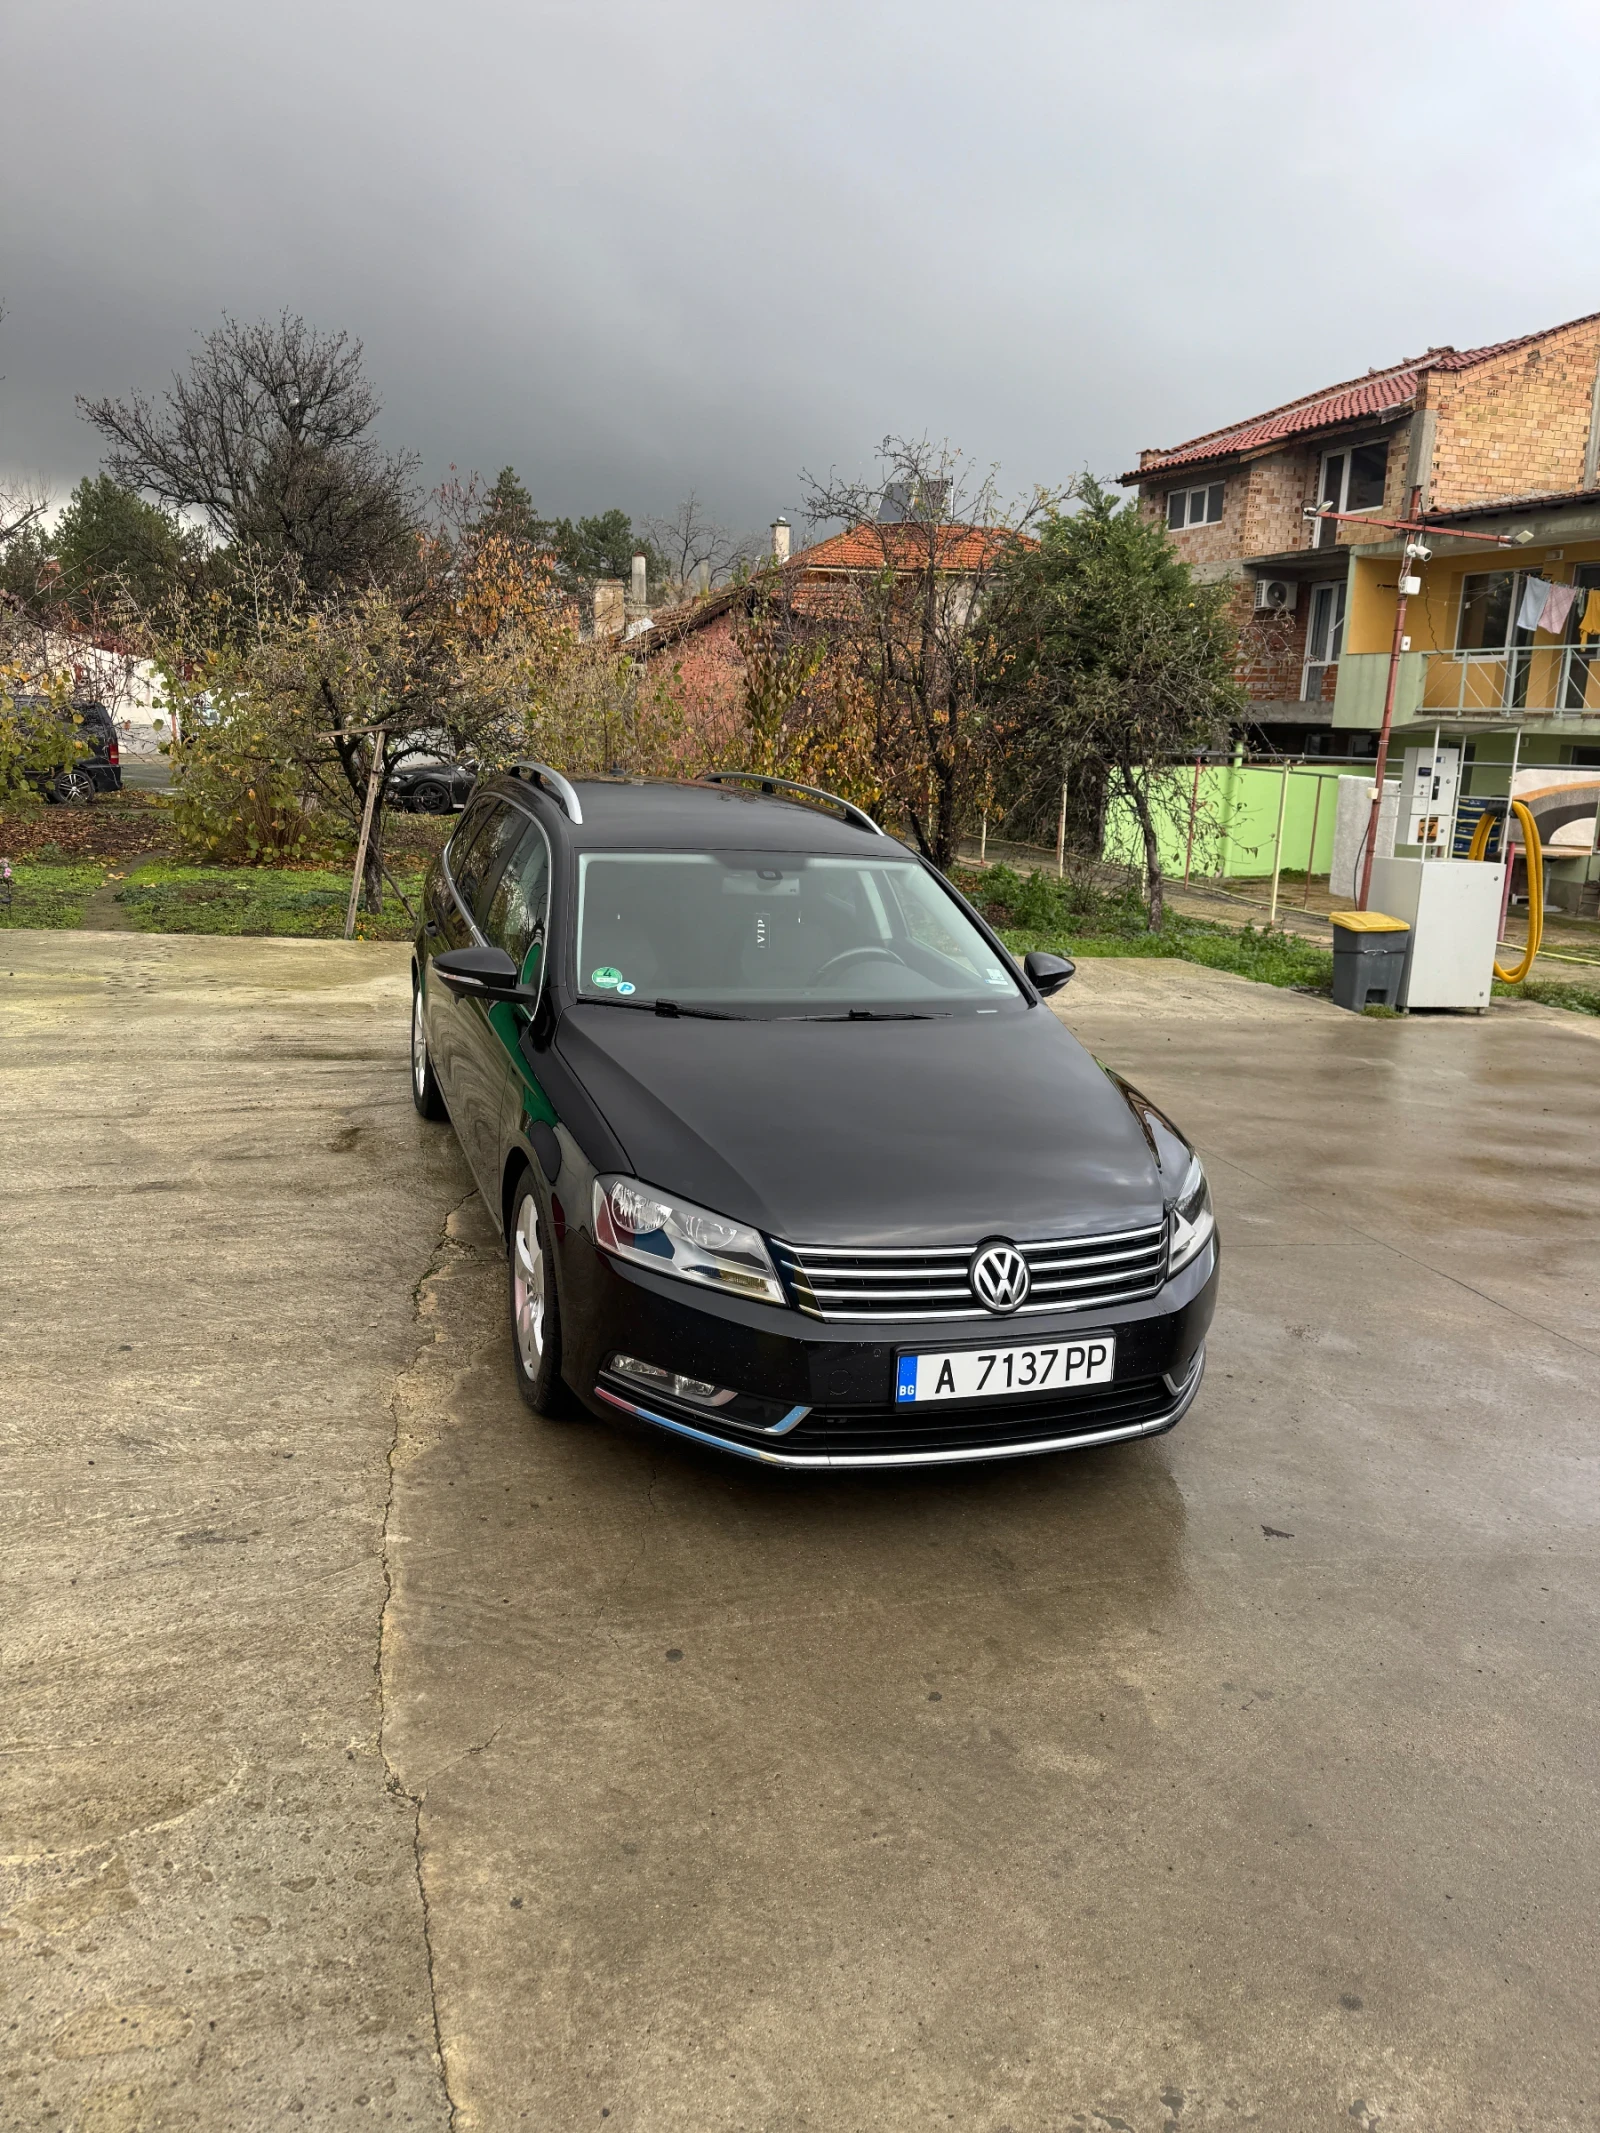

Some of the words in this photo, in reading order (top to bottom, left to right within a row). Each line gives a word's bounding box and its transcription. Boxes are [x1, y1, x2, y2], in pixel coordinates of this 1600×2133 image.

[757, 919, 766, 944] VIP
[602, 968, 612, 978] 4
[620, 983, 633, 992] P
[974, 1247, 1028, 1311] VW
[934, 1359, 956, 1394] A
[899, 1385, 915, 1396] BG
